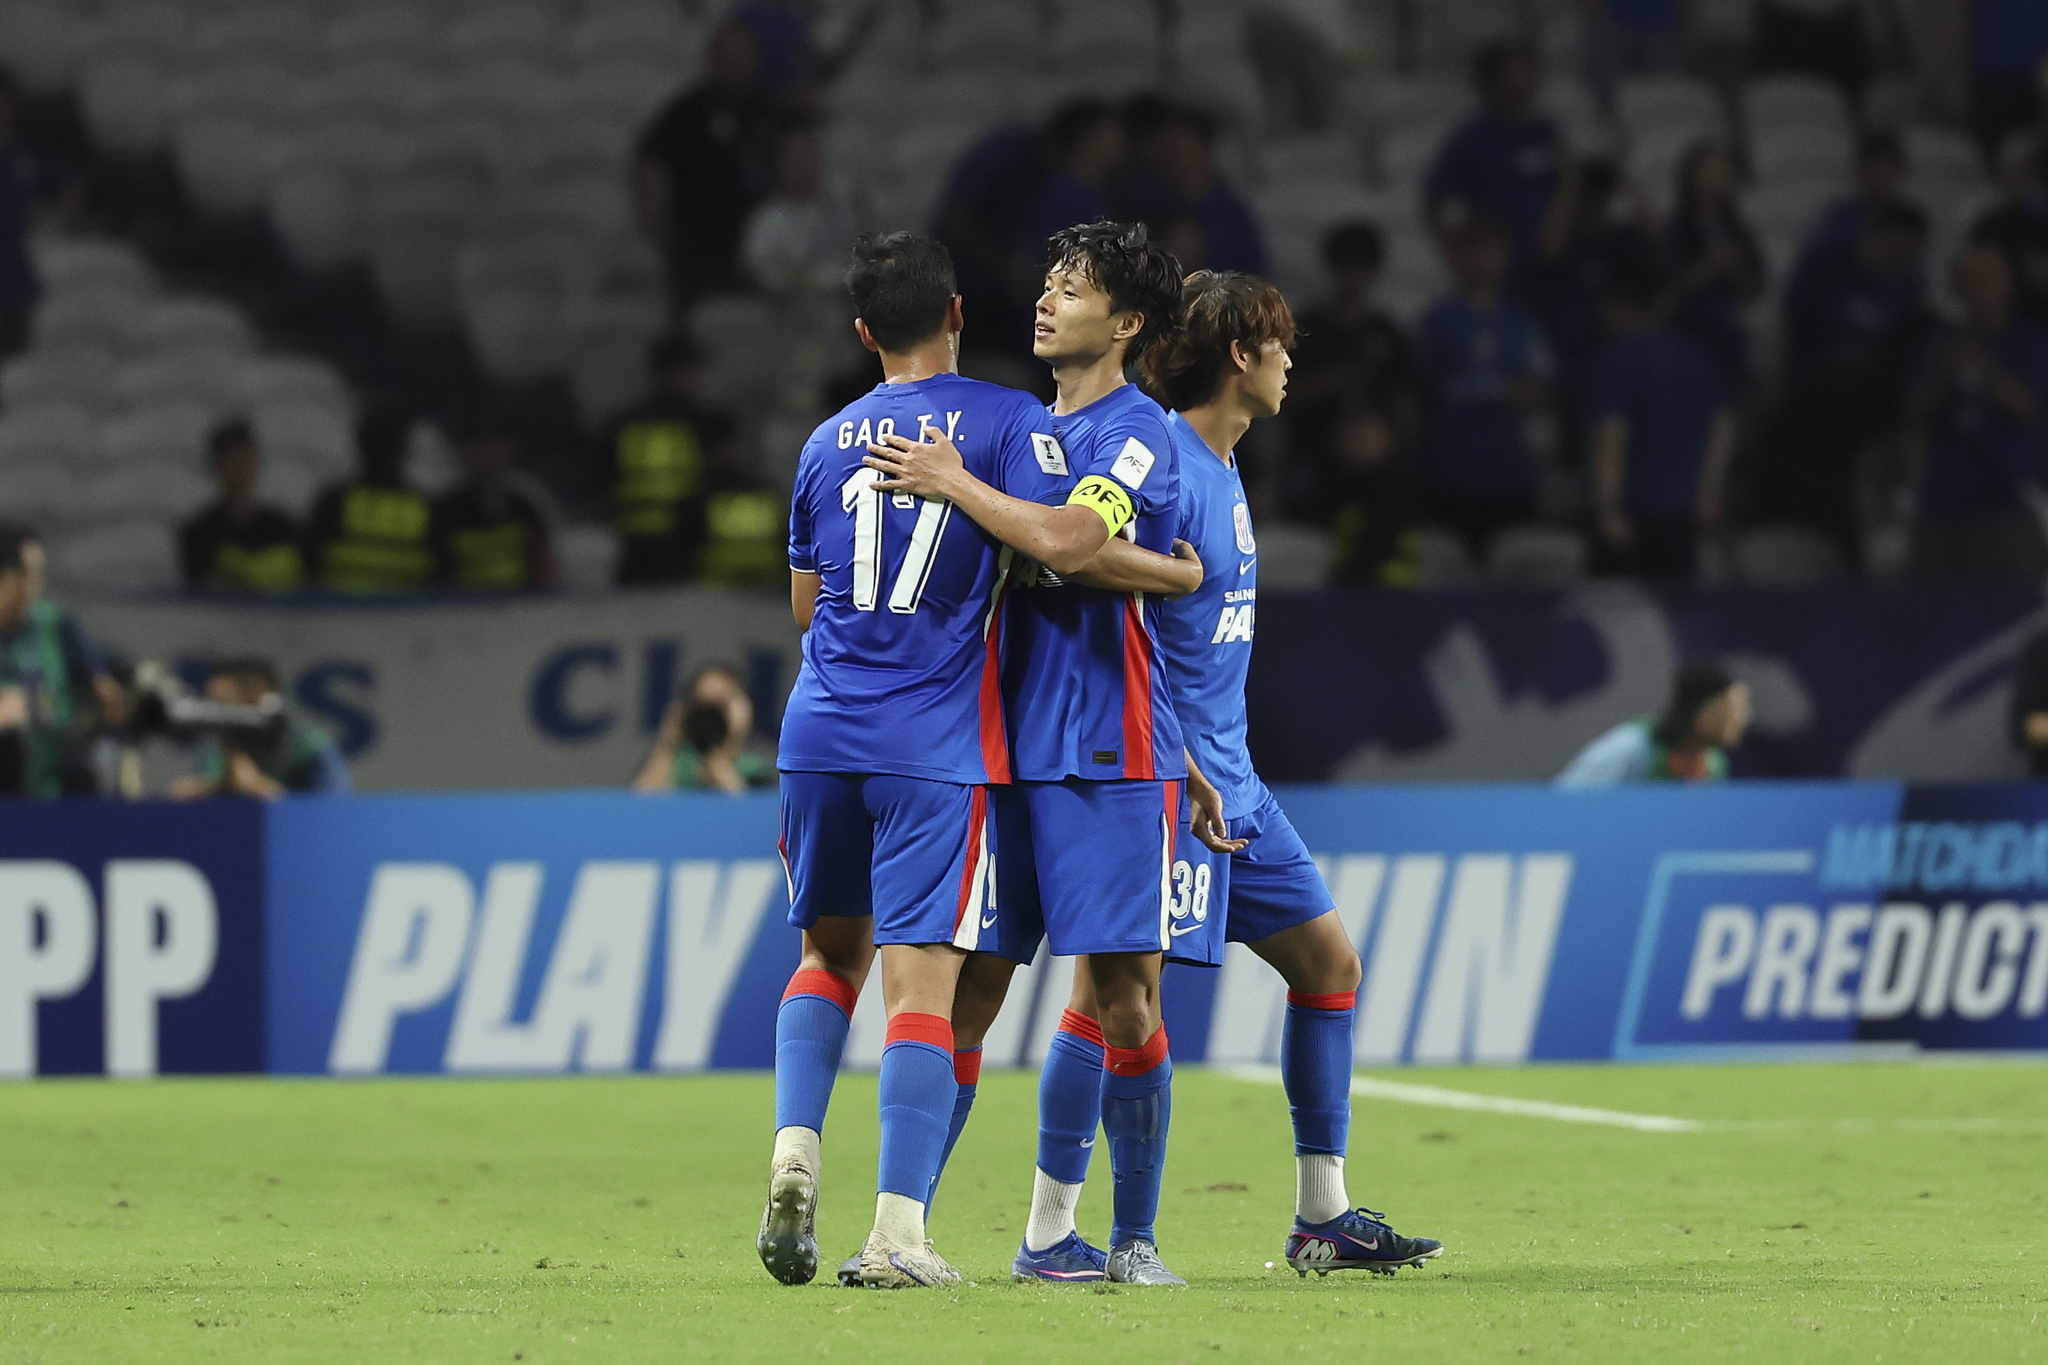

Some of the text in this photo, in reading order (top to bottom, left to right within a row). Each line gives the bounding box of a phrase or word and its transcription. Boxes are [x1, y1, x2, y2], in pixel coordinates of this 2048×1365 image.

[837, 417, 895, 450] GAO
[1122, 455, 1145, 474] AFC
[1072, 483, 1127, 525] AFC
[841, 467, 954, 615] 17
[1211, 604, 1255, 645] PA
[1170, 860, 1211, 921] 38
[328, 861, 779, 1072] PLAY
[1681, 901, 2048, 1020] PREDICT
